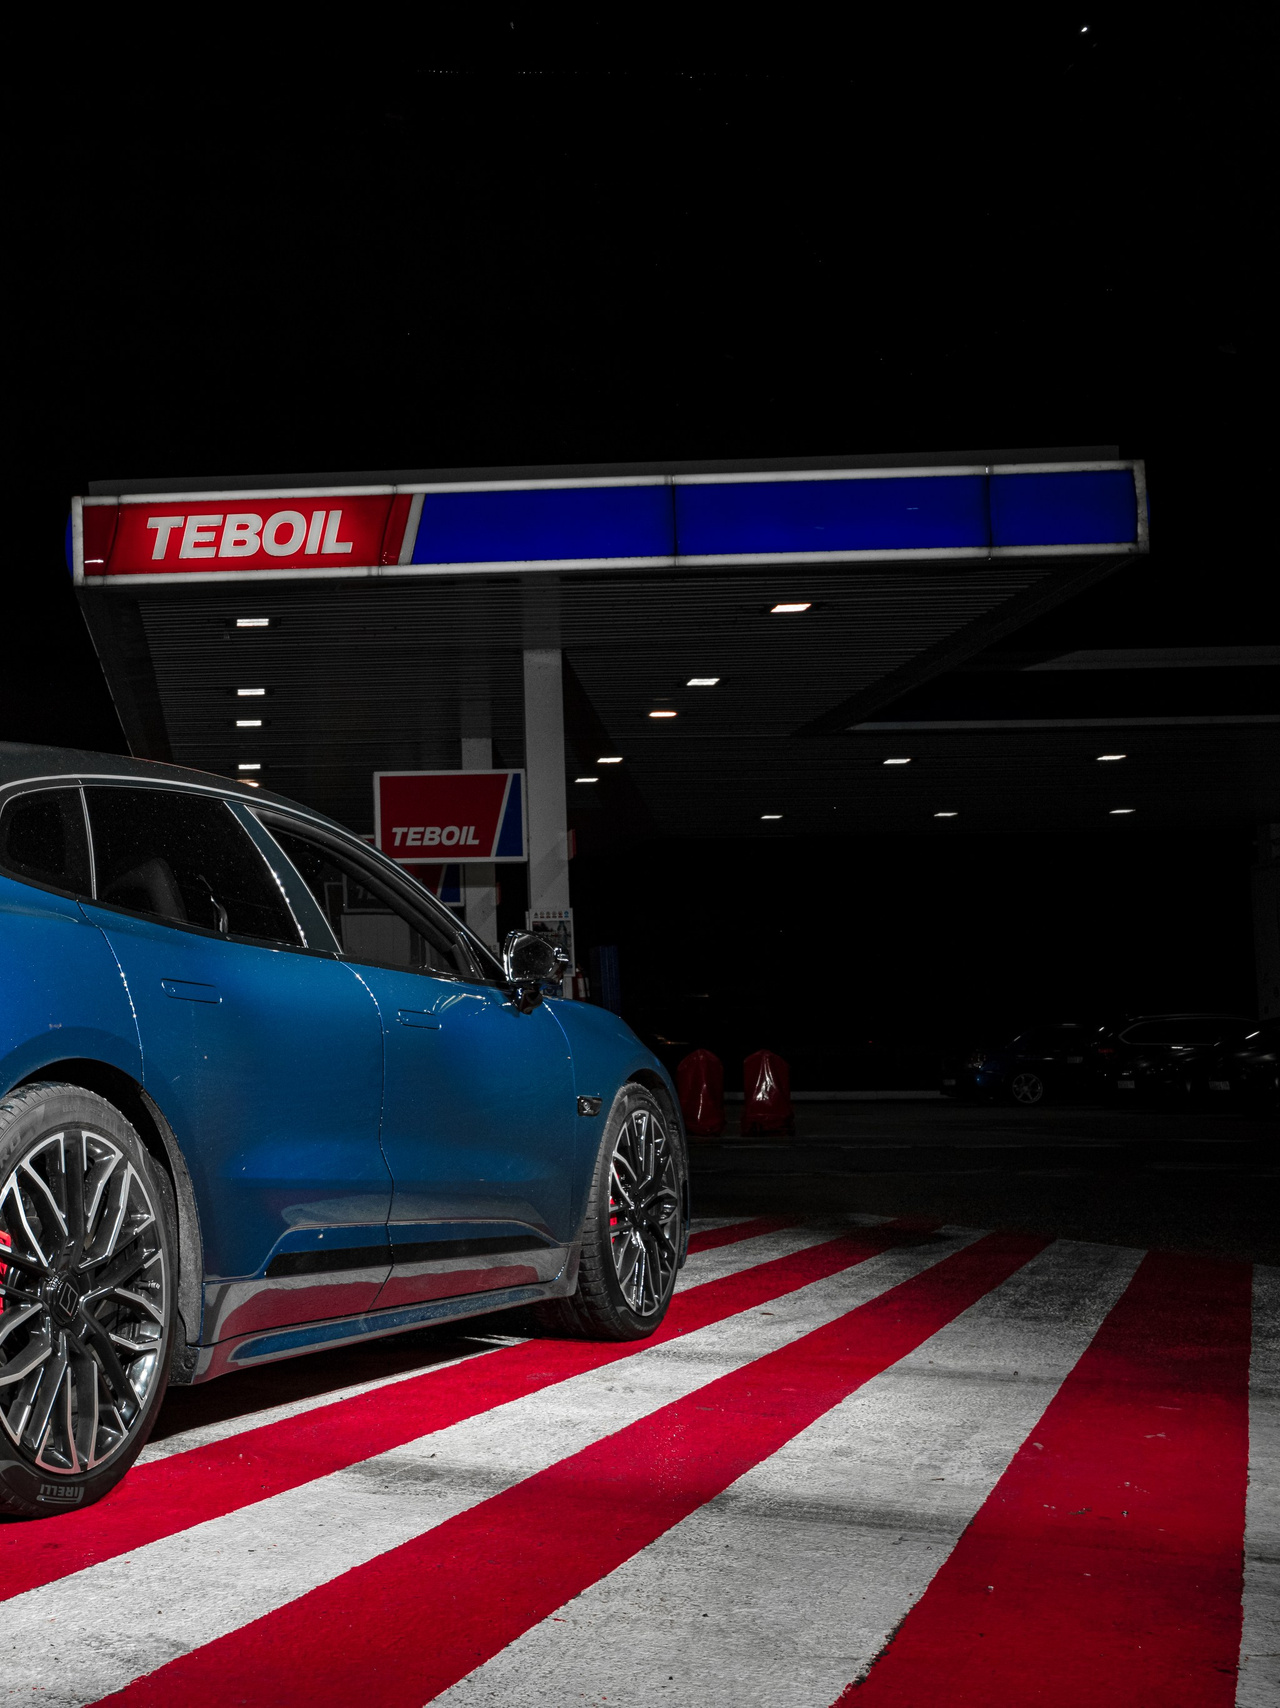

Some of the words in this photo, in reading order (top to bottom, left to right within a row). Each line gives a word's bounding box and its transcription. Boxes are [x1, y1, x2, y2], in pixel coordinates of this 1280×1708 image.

[146, 509, 354, 560] TEBOIL
[391, 825, 480, 847] TEBOIL
[36, 1483, 85, 1504] PIRELLI
